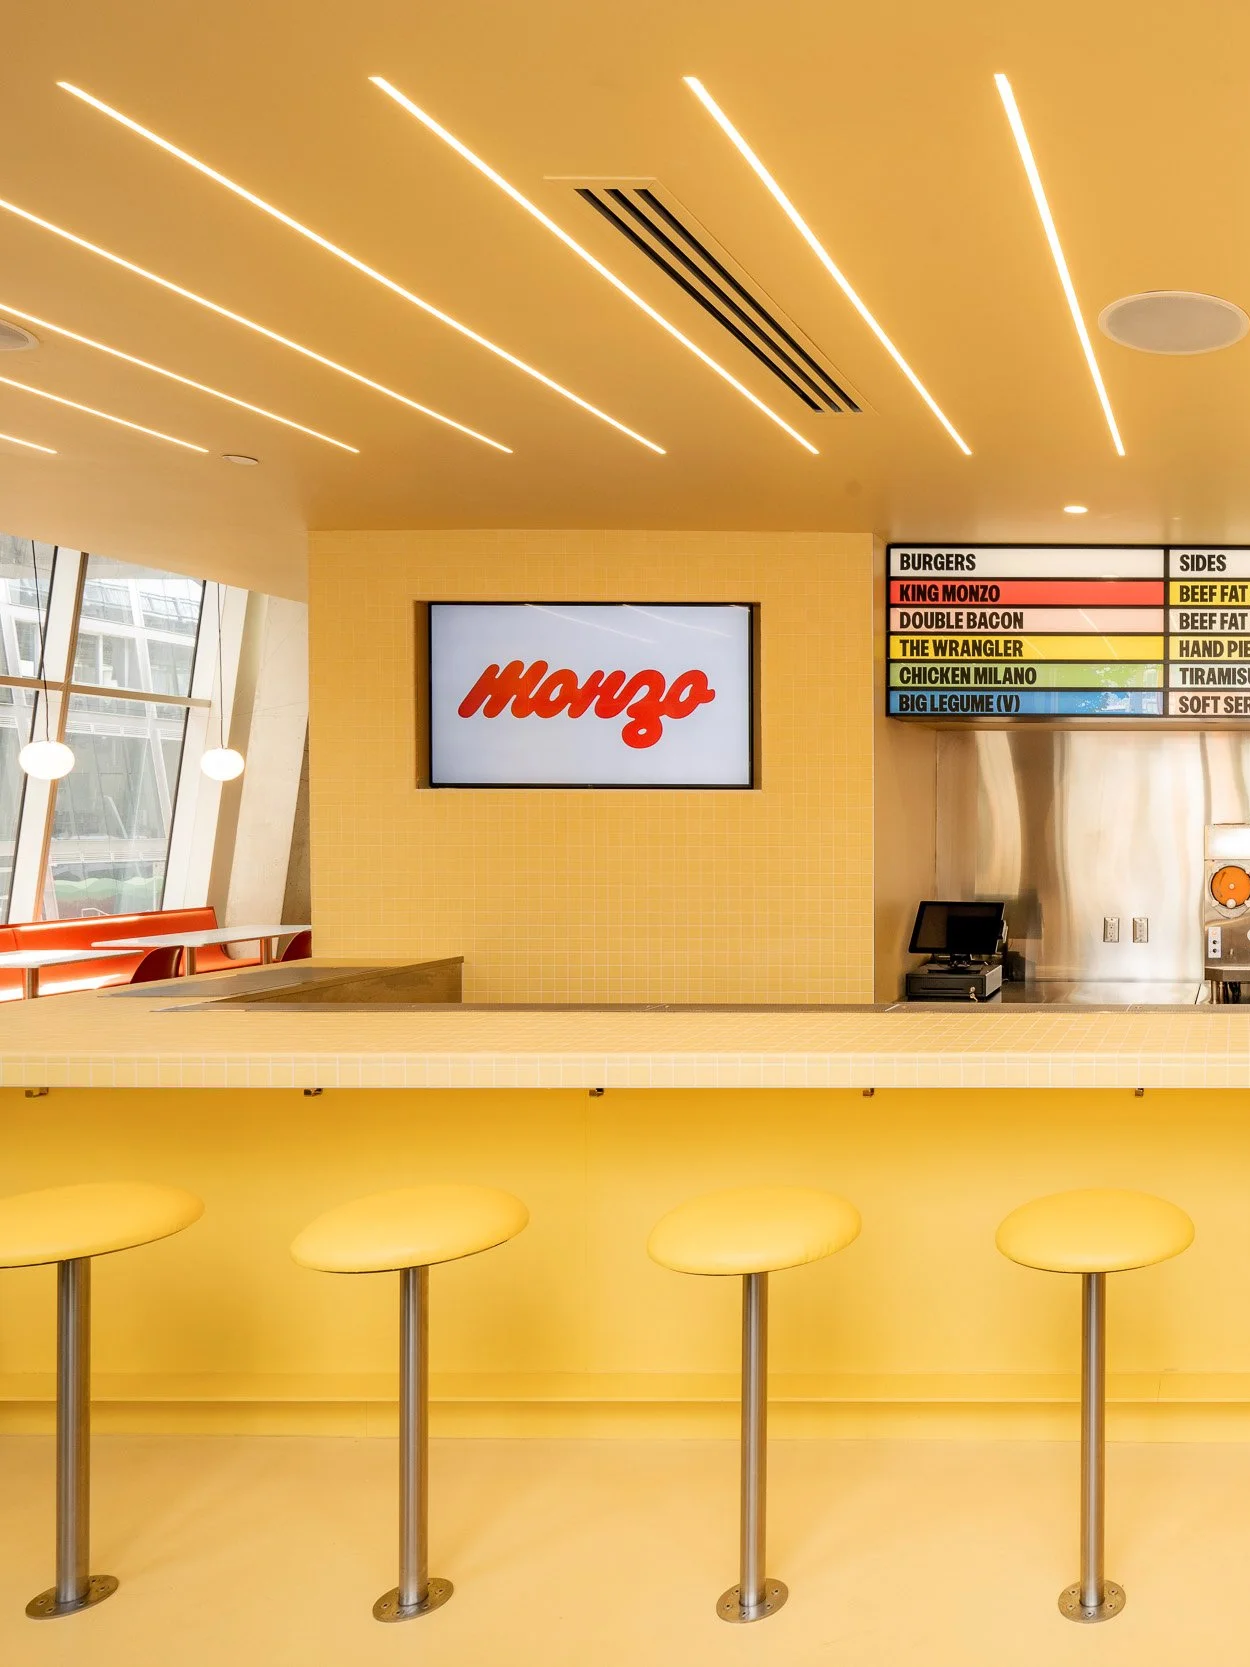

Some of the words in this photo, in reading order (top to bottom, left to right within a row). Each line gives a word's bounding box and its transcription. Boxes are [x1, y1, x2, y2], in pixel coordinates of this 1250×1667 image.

[899, 554, 976, 570] BURGERS
[1179, 555, 1227, 571] SIDES
[899, 585, 940, 601] KING
[941, 585, 1001, 602] MONZO
[1179, 585, 1218, 602] BEEF
[1220, 585, 1249, 602] FAT
[899, 612, 964, 629] DOUBLE
[966, 612, 1024, 629] BACON
[1179, 613, 1217, 629] BEEF
[1219, 613, 1249, 630] FAT
[899, 640, 930, 656] THE
[931, 640, 1024, 657] WRANGLER
[1179, 640, 1225, 657] HAND
[898, 667, 971, 684] CHICKEN
[973, 667, 1037, 684] MILANO
[898, 695, 928, 711] BIG
[929, 695, 994, 712] LEGUME
[996, 695, 1021, 712] (V)
[1178, 696, 1221, 713] SOFT
